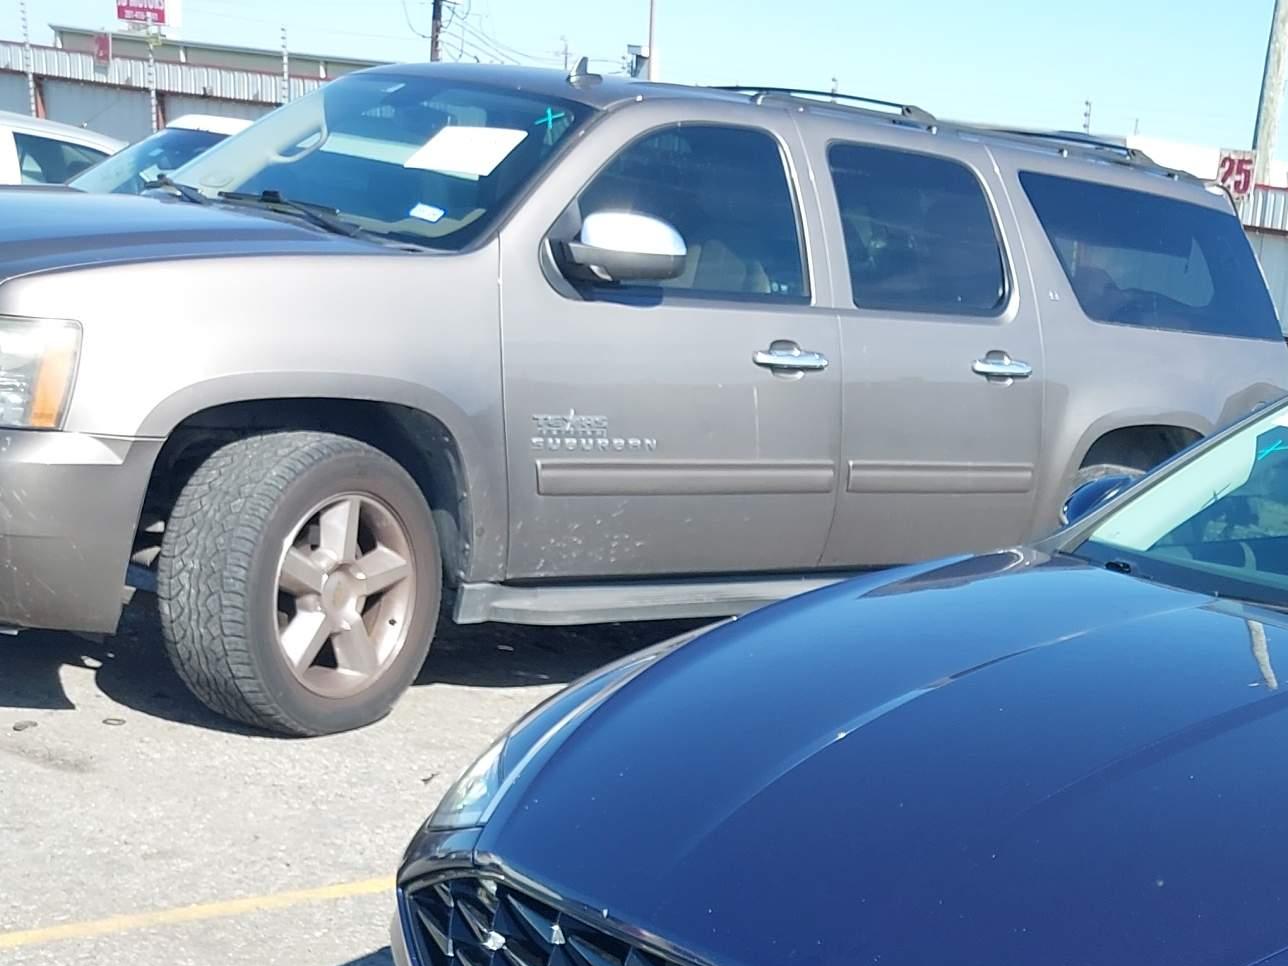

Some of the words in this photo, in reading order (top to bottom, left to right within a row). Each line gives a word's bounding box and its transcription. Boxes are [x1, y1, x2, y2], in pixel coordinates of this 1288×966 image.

[1220, 156, 1253, 194] 25
[532, 413, 608, 430] TEXAS
[531, 437, 657, 451] SUBURBAN
